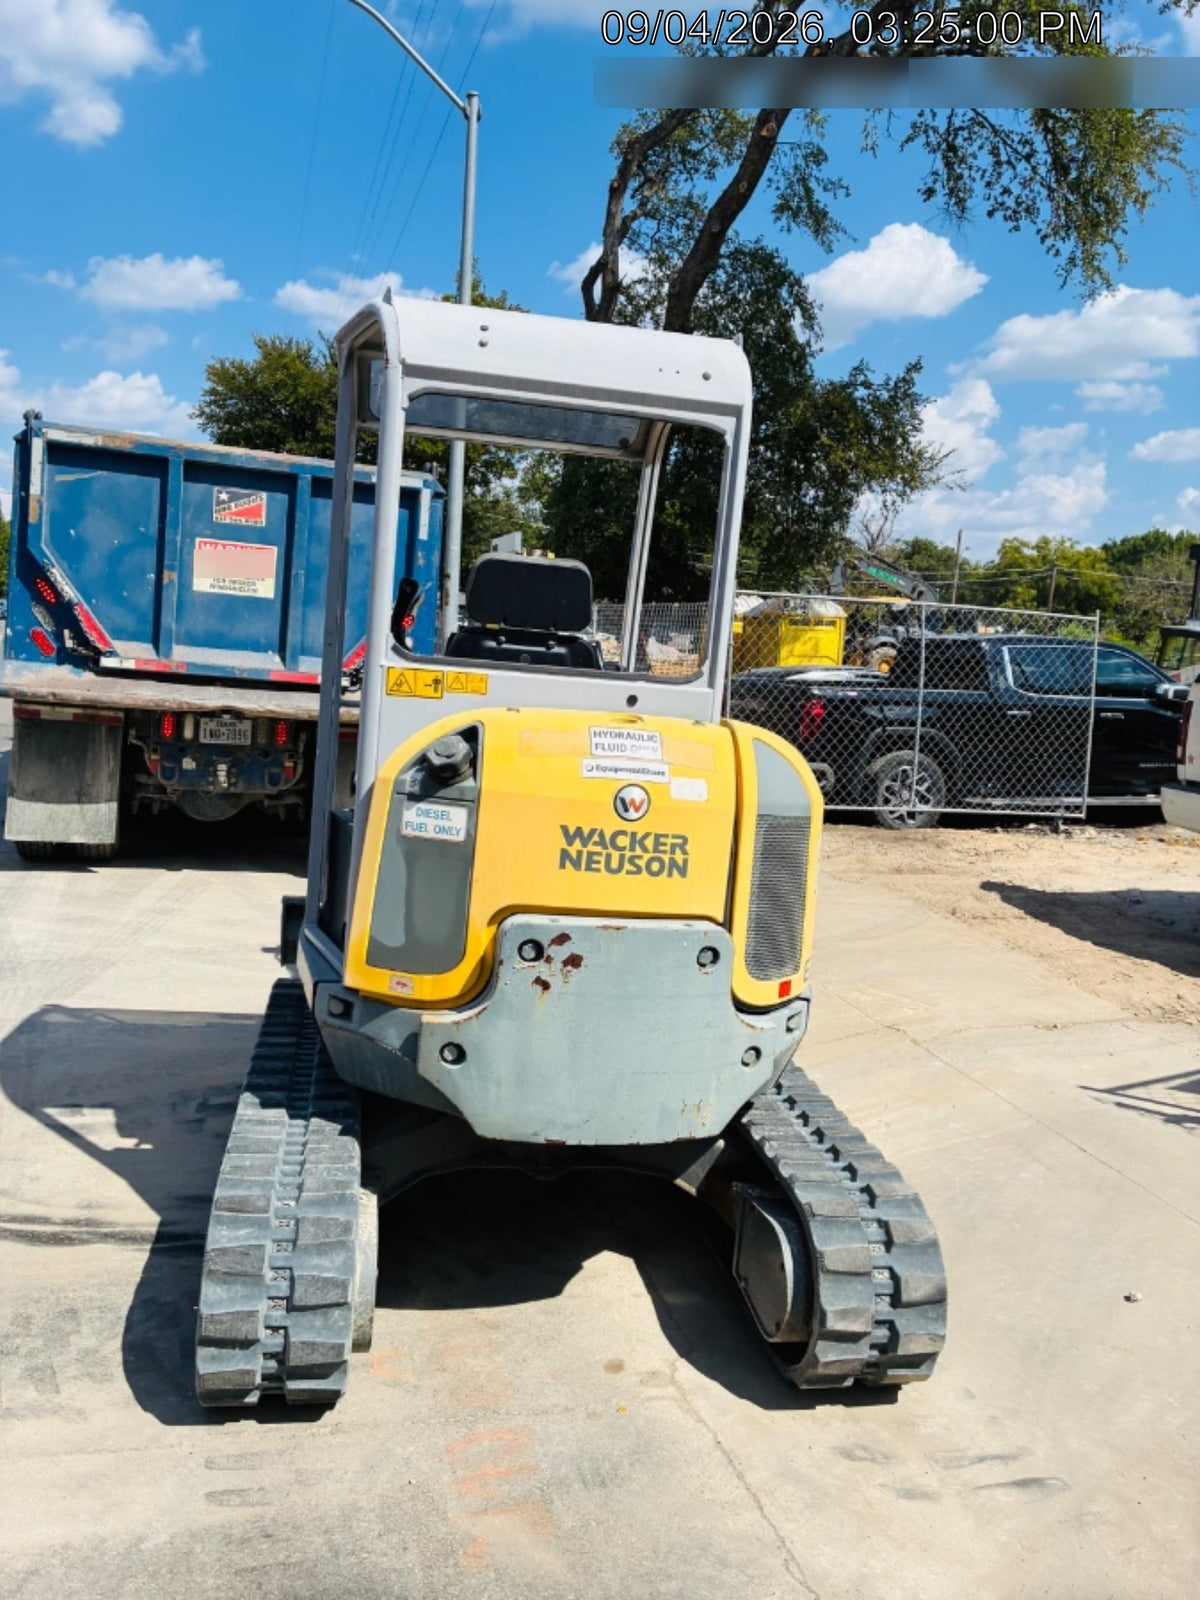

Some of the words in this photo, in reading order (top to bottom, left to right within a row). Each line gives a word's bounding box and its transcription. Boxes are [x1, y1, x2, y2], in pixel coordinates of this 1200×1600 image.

[593, 730, 658, 743] HYDRAULIC
[594, 742, 627, 753] FLUID
[415, 806, 453, 822] DIESEL
[404, 820, 430, 833] FUEL
[433, 823, 462, 837] ONLY
[559, 824, 689, 856] WACKER
[558, 847, 689, 879] NEUSON
